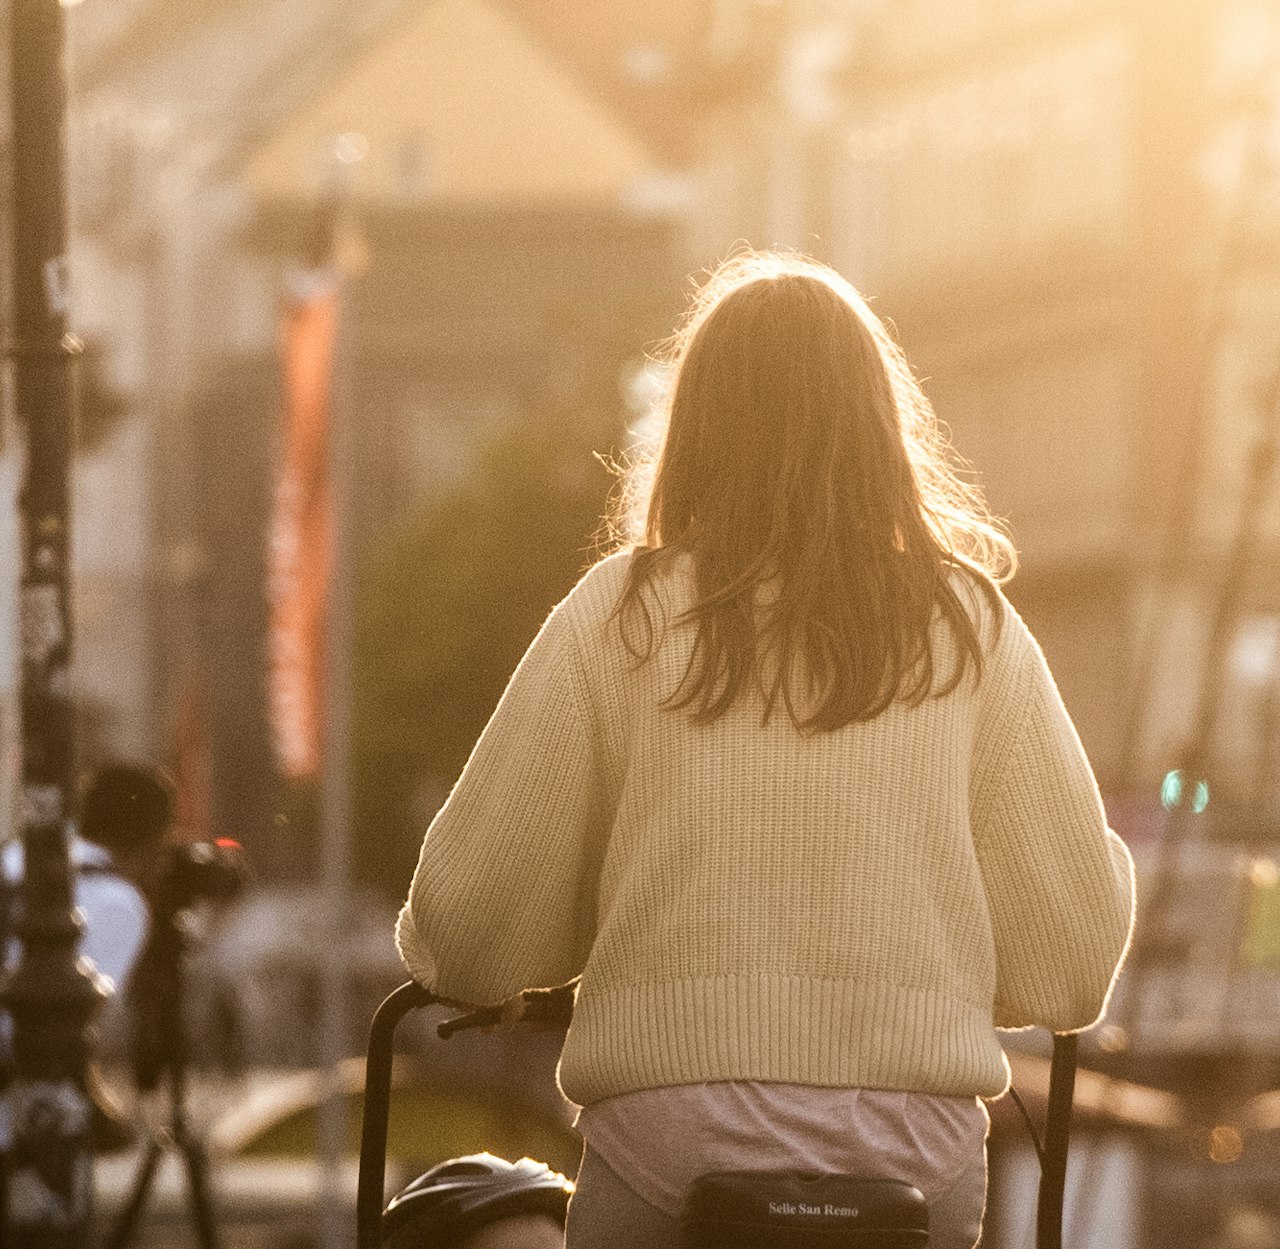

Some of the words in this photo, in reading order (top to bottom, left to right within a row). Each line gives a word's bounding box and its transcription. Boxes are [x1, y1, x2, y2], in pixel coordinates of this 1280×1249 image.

[769, 1202, 797, 1215] Selle
[798, 1203, 821, 1215] San
[824, 1204, 859, 1217] Remo
